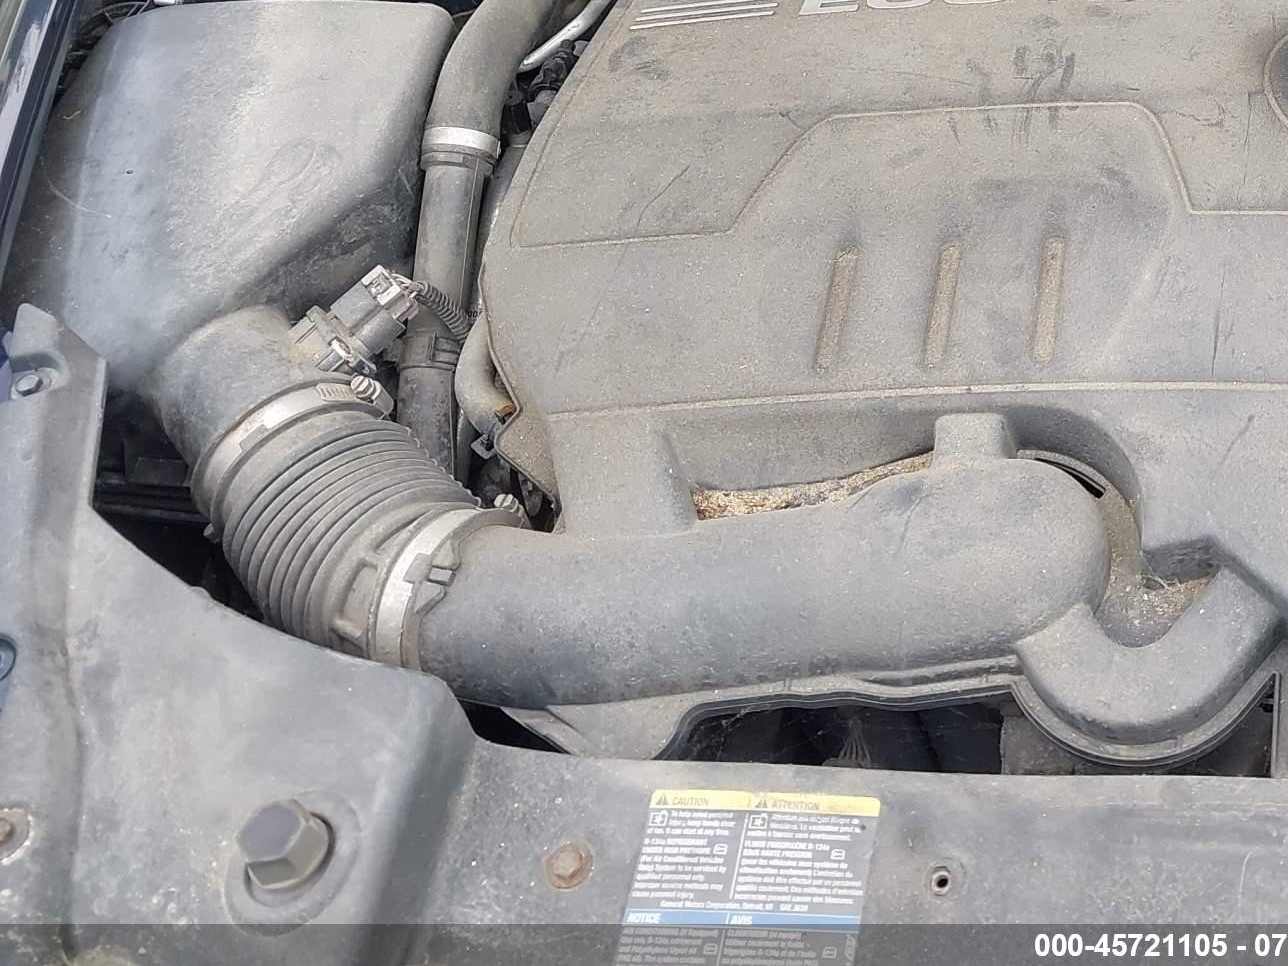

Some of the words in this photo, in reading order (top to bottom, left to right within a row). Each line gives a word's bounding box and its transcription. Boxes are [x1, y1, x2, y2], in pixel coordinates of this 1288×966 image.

[671, 796, 710, 807] CAUTION
[771, 799, 820, 811] ATTENTION
[627, 912, 661, 924] NOTICE
[729, 914, 753, 925] AVIS
